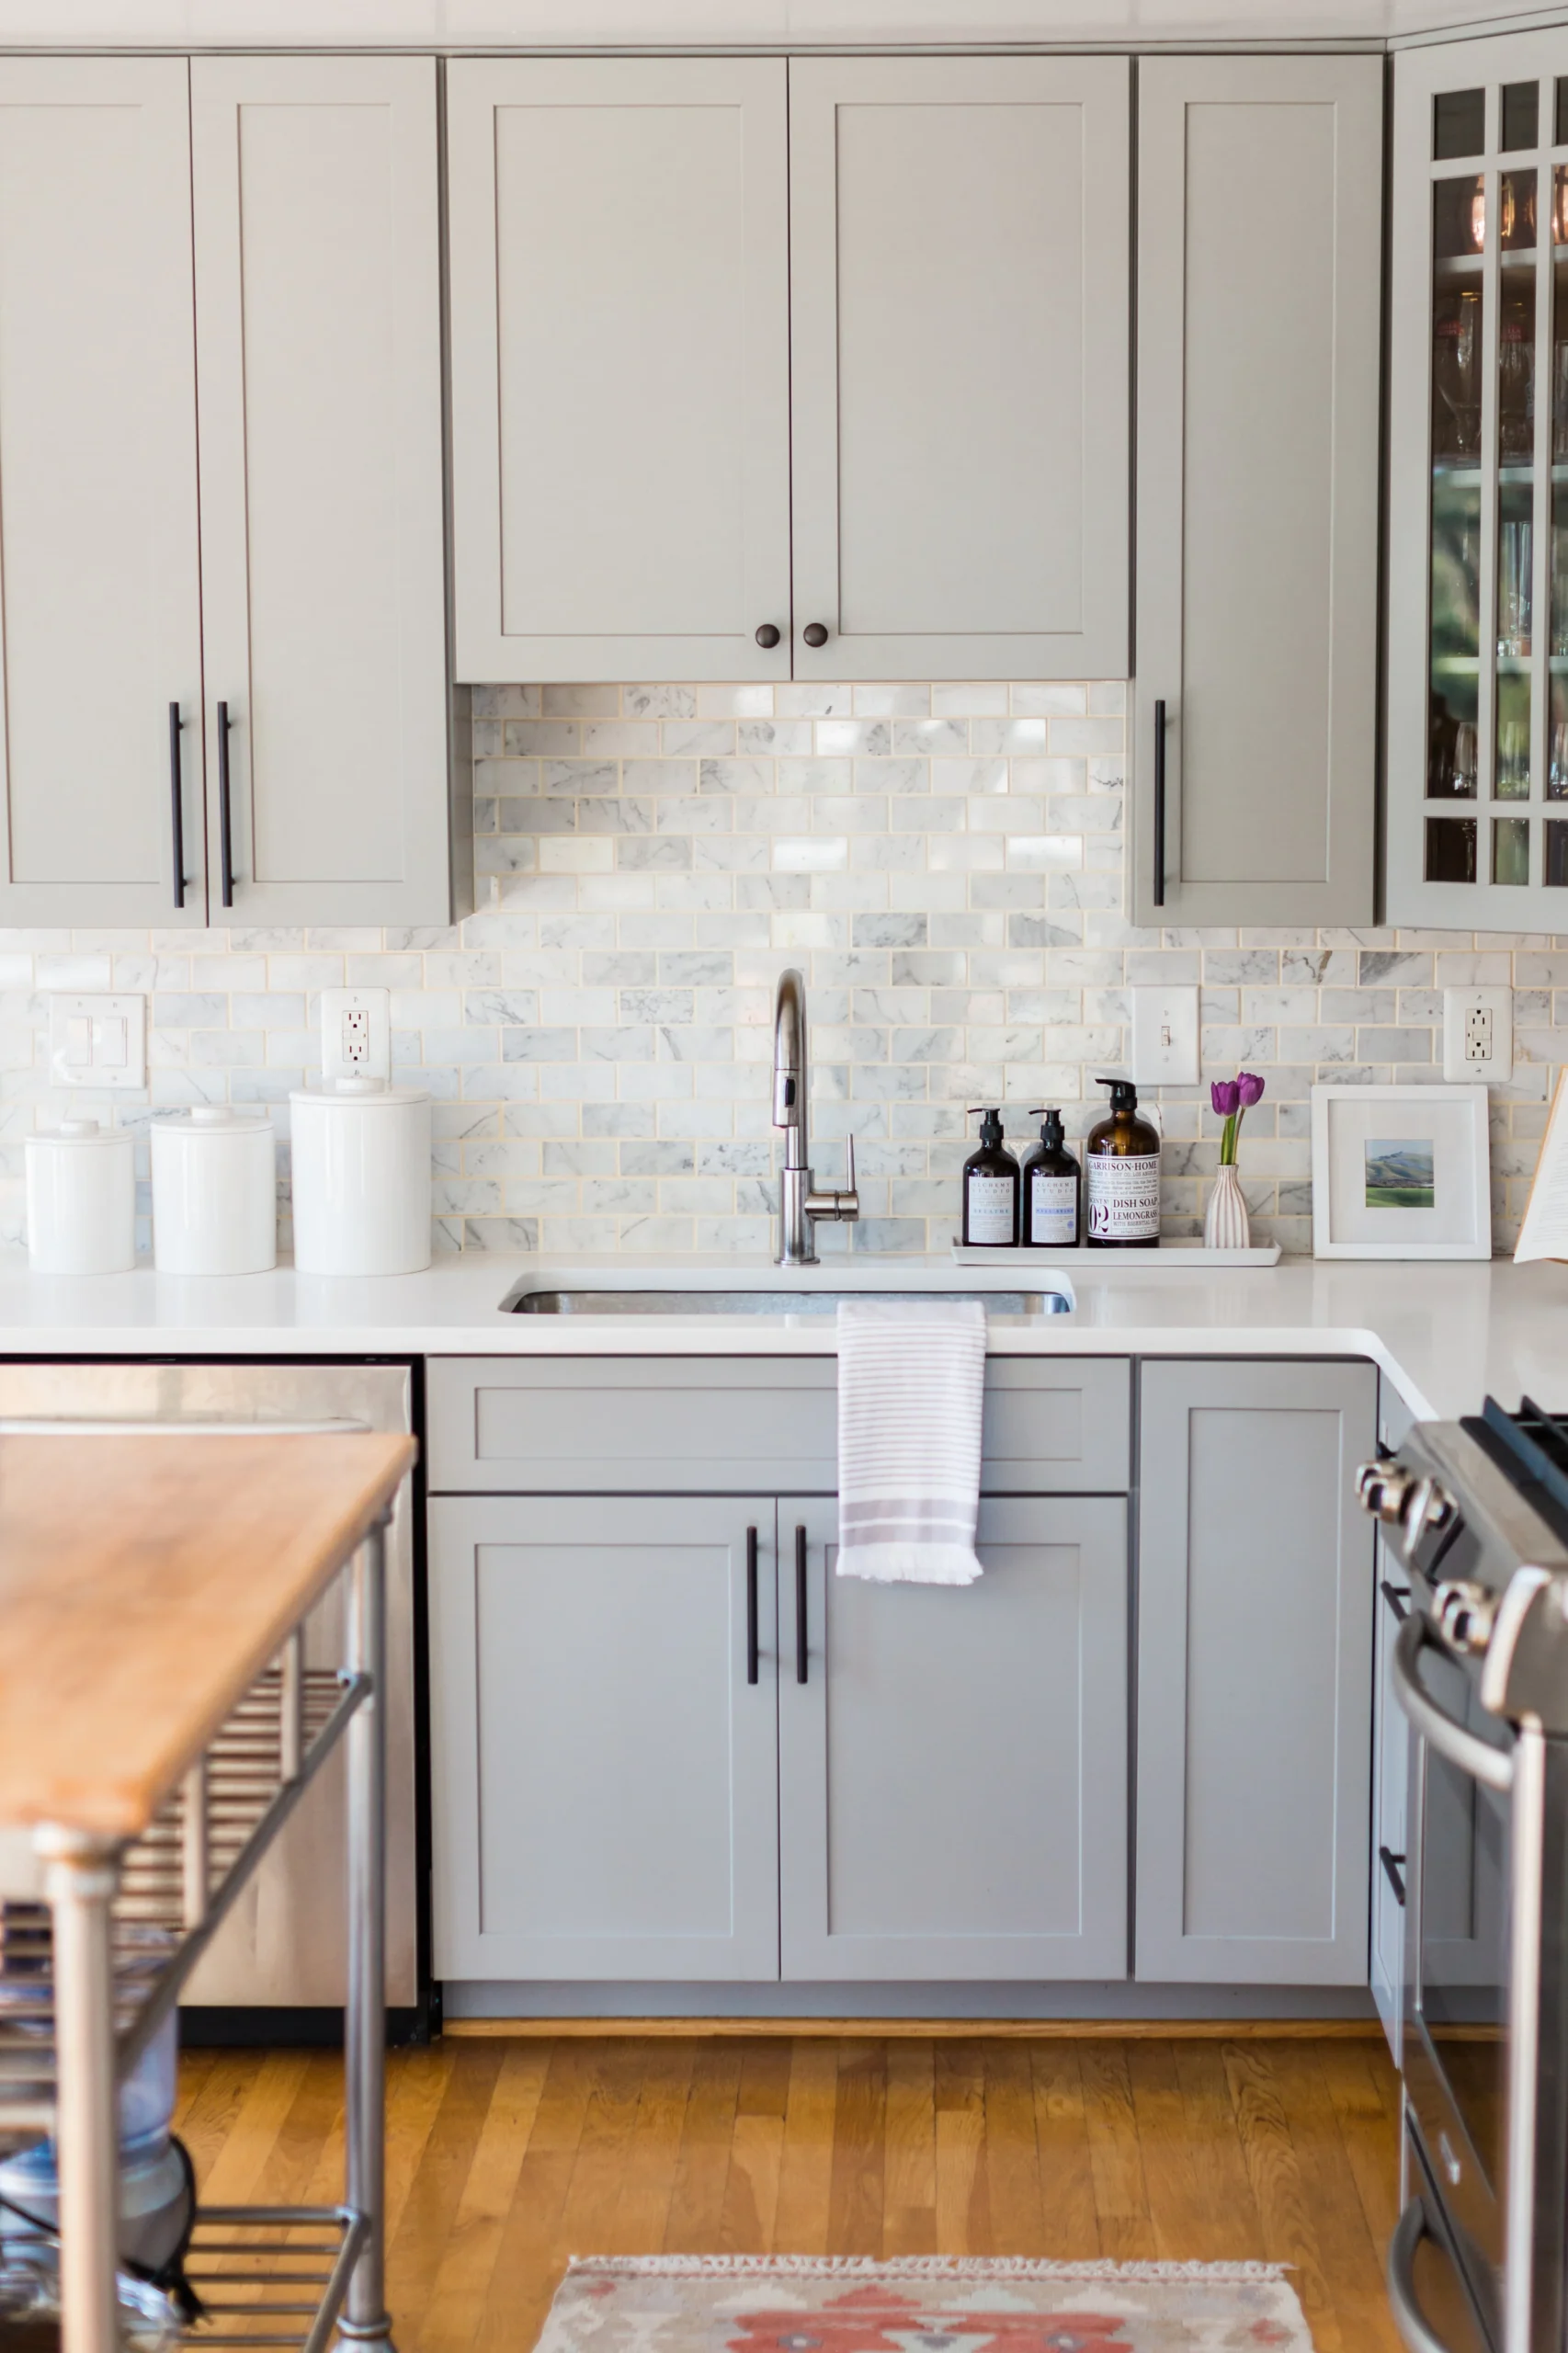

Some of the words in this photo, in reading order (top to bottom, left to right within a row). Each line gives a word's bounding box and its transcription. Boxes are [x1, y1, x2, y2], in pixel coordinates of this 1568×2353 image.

[1113, 1199, 1137, 1208] DISH
[1139, 1197, 1158, 1208] SOAP
[1089, 1203, 1109, 1233] 02
[1113, 1210, 1158, 1220] LEMONGRASS
